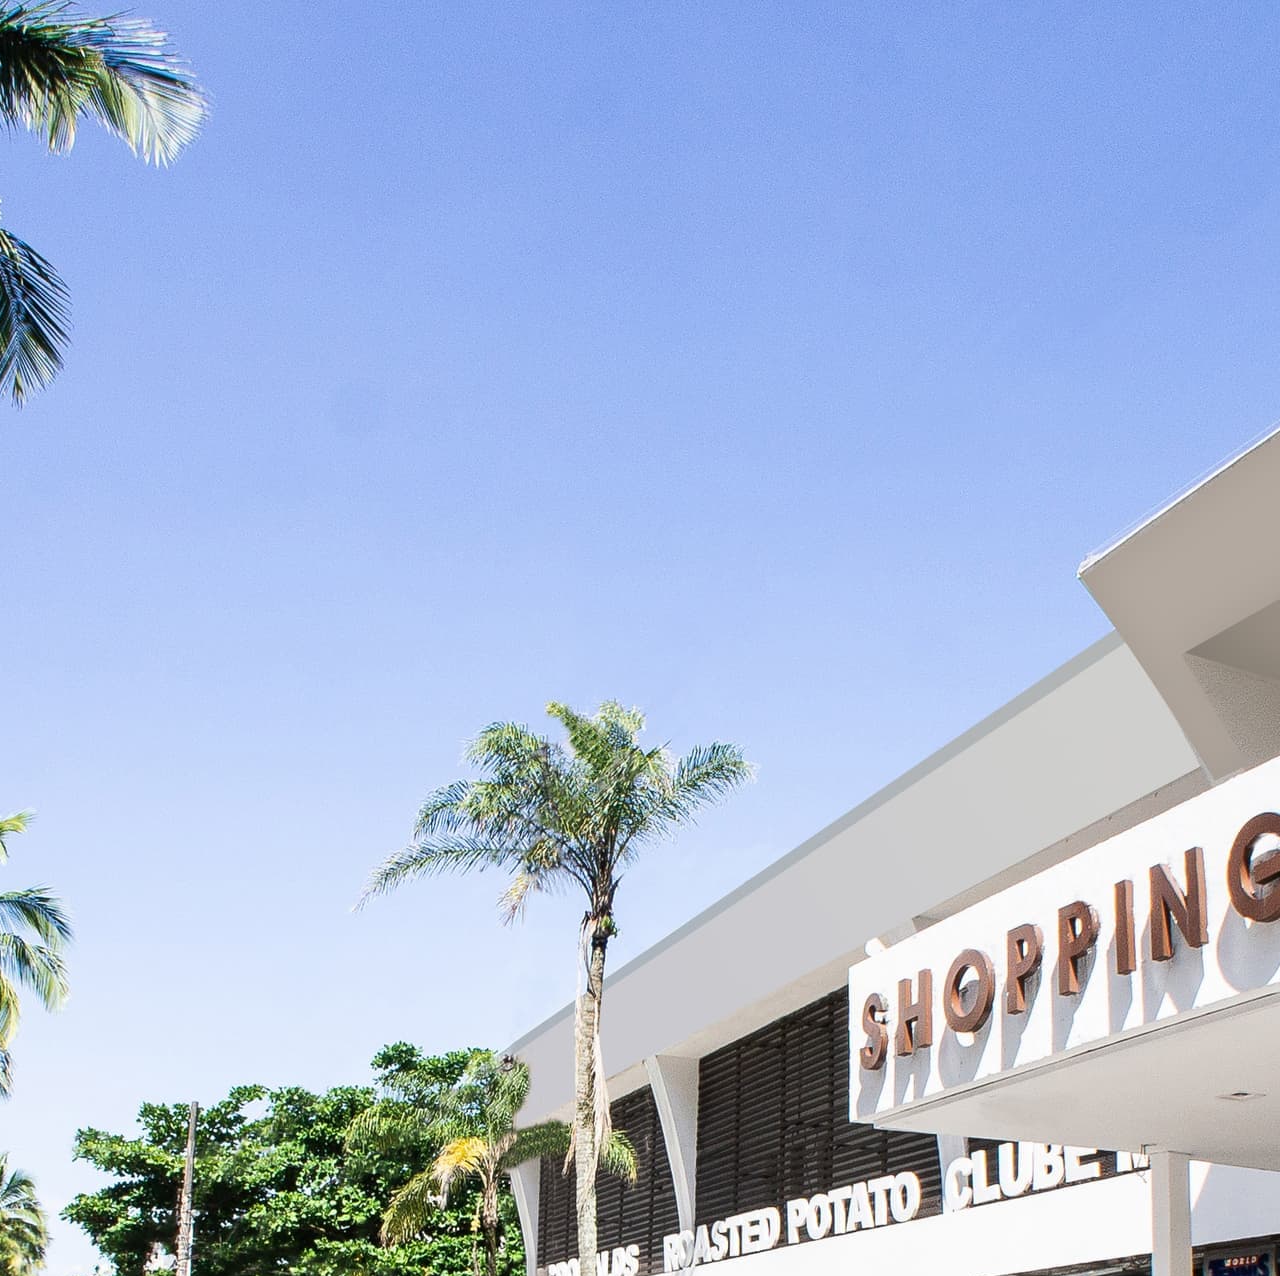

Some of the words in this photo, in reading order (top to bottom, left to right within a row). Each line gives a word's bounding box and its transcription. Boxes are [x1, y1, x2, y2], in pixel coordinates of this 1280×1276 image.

[944, 1140, 1103, 1212] CLUBE
[662, 1205, 781, 1274] ROASTED
[786, 1170, 921, 1245] POTATO
[1224, 1255, 1257, 1267] WORLD
